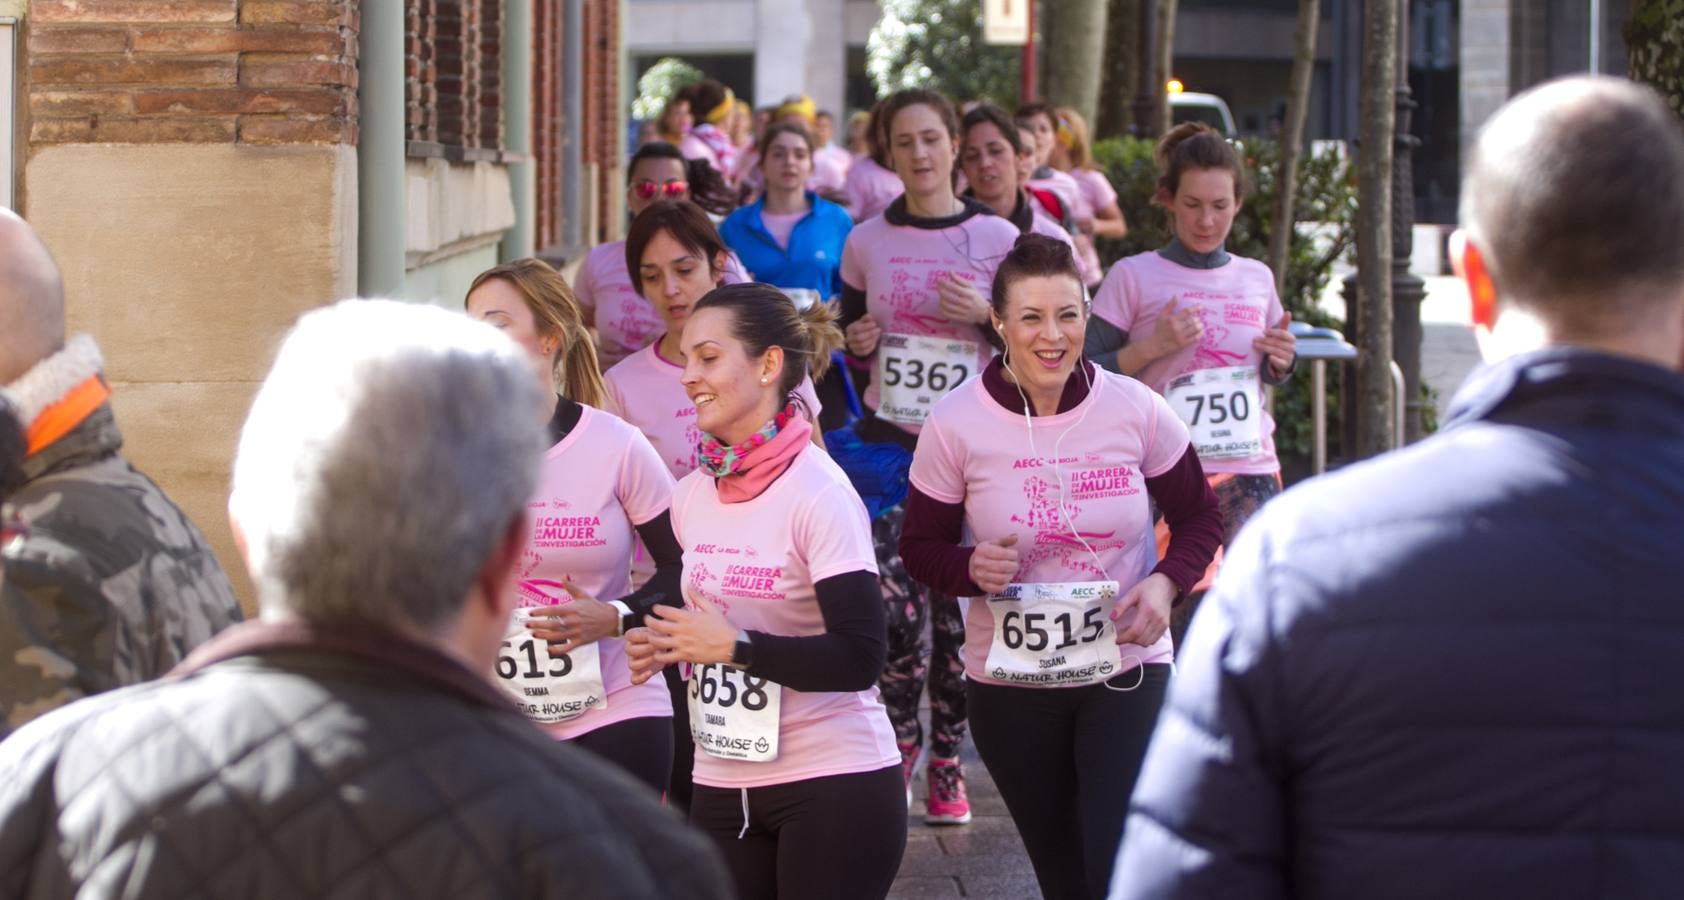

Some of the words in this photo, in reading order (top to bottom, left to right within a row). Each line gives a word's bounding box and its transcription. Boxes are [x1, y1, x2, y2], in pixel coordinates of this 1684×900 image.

[884, 357, 968, 391] 5362
[675, 407, 696, 418] AEC
[1185, 391, 1249, 426] 750
[1013, 458, 1044, 469] AECC
[1080, 467, 1133, 480] CARRERA
[1080, 478, 1129, 493] MUJER
[544, 517, 600, 527] CARRERA
[543, 527, 594, 539] MUJER
[694, 544, 716, 554] AECC
[733, 565, 782, 578] CARRERA
[728, 576, 774, 591] MUJER
[1071, 587, 1095, 596] AECC
[1002, 607, 1104, 651] 6515
[1039, 656, 1067, 669] SUSANA
[1010, 673, 1053, 682] NATUR
[1057, 665, 1097, 680] HOUSE
[542, 700, 582, 714] HOUSE
[715, 735, 752, 750] HOUSE
